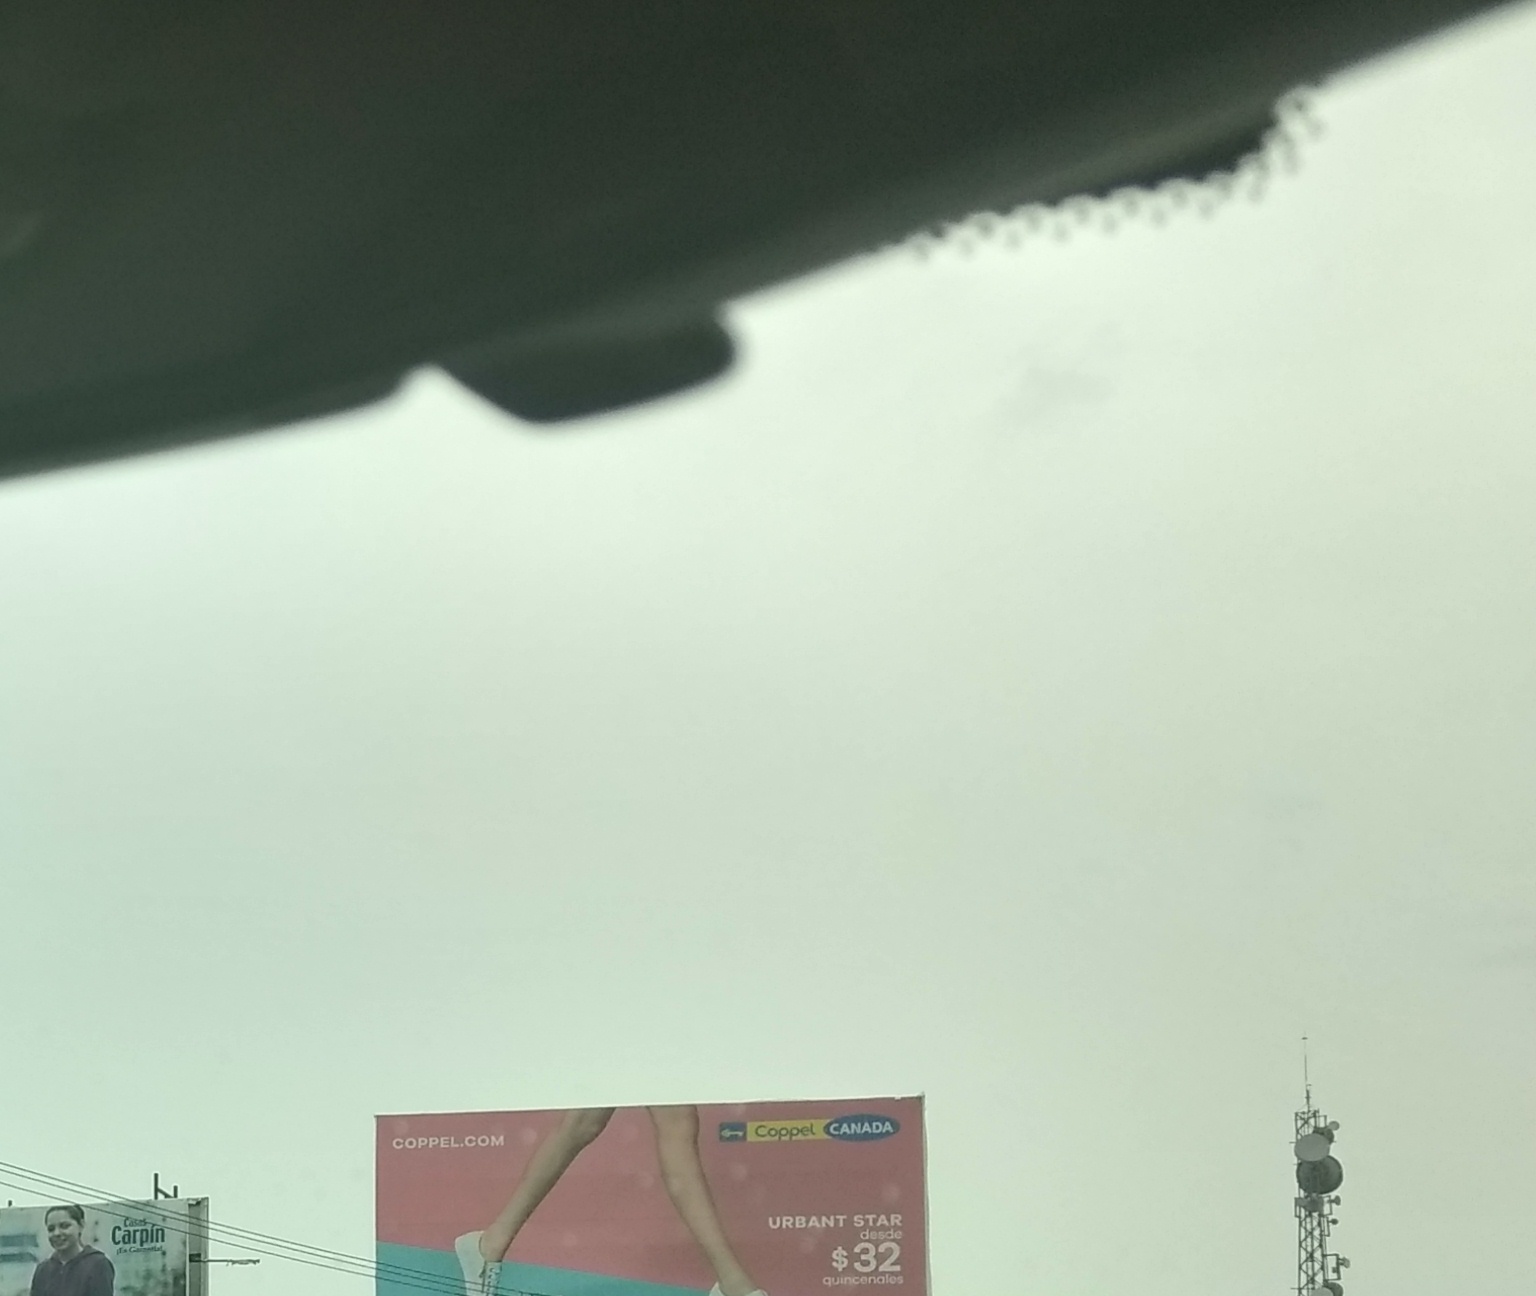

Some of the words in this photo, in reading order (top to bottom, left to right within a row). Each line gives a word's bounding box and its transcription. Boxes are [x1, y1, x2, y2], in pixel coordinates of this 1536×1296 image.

[754, 1123, 817, 1142] Coppel
[828, 1121, 894, 1135] CANADA
[392, 1135, 505, 1149] COPPEL.COM
[768, 1215, 847, 1229] URBANT
[853, 1214, 903, 1228] STAR
[111, 1224, 165, 1247] Carpín
[860, 1229, 903, 1240] desde
[822, 1273, 904, 1287] quincenales
